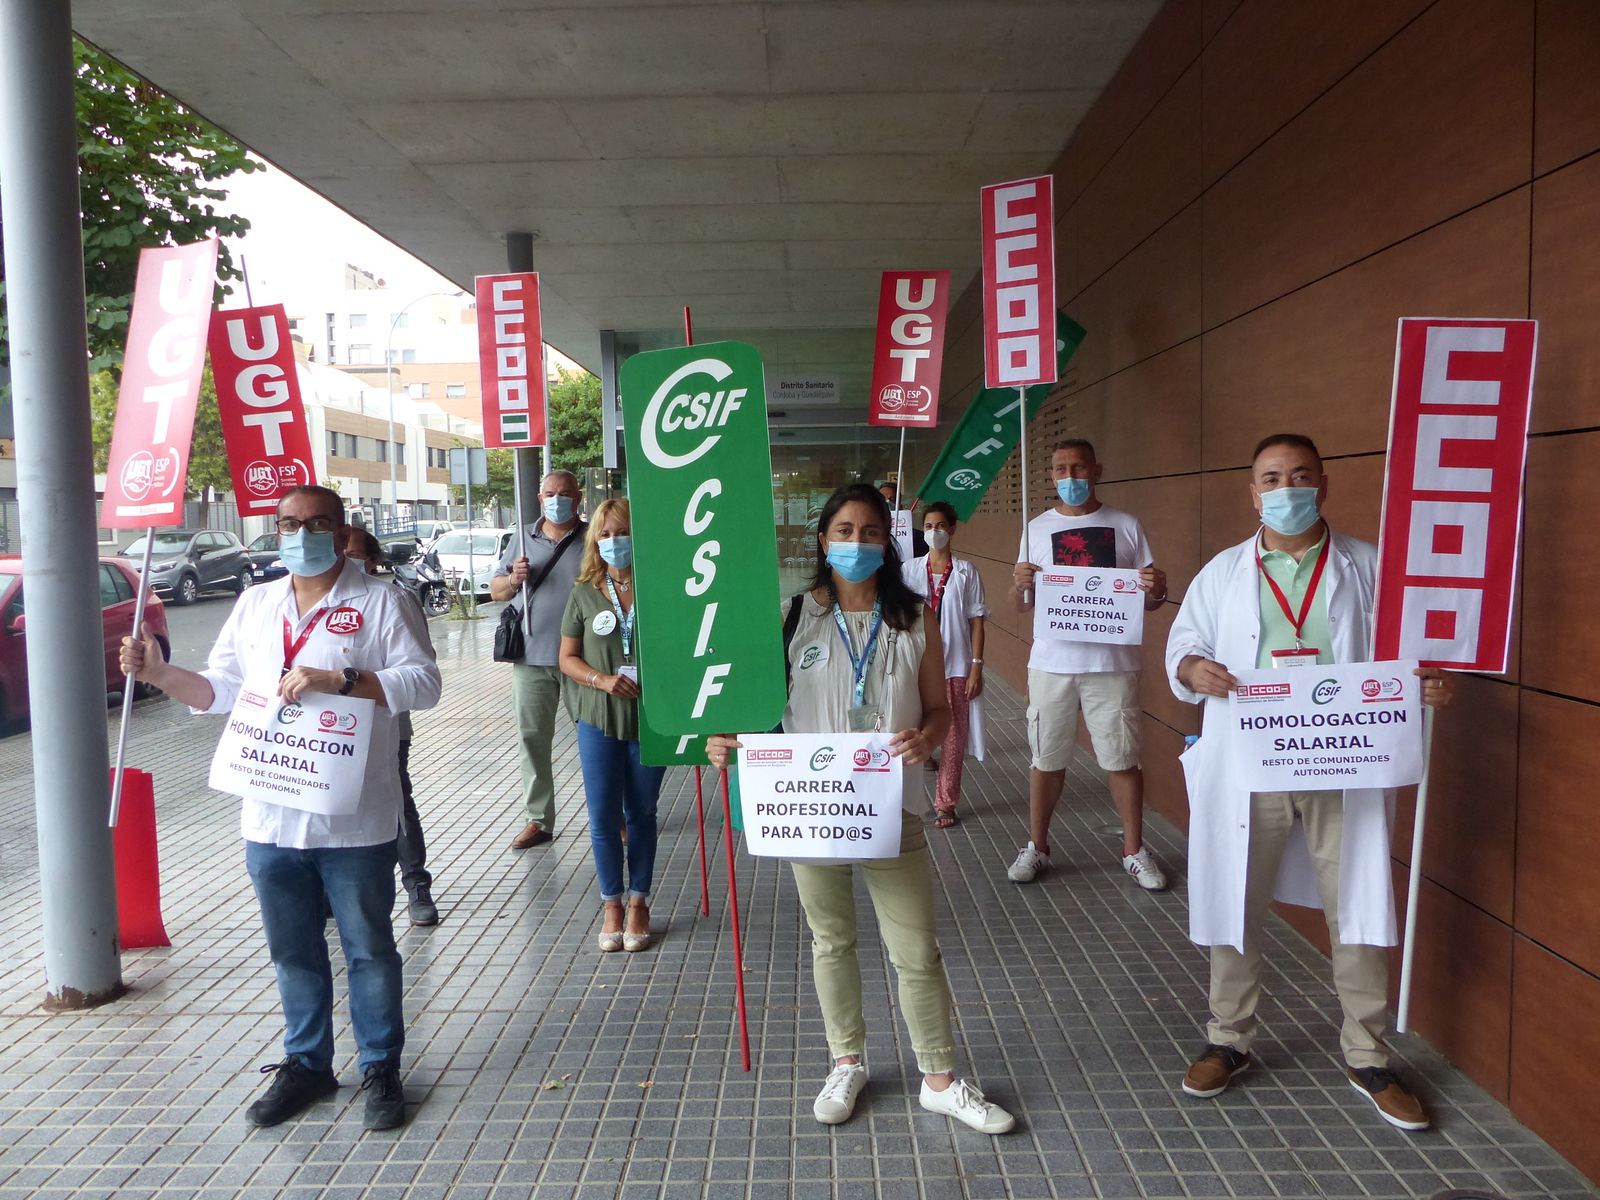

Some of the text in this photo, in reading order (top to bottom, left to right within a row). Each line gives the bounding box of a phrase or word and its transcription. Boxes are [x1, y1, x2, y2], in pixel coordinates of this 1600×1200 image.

[993, 182, 1040, 383] CCOO
[889, 278, 937, 382] UGT
[142, 252, 211, 445] UGT
[492, 279, 529, 411] CCOO
[226, 315, 294, 457] UGT
[780, 381, 834, 390] Distrito Sanitario
[882, 388, 902, 400] UGT
[248, 466, 272, 482] UGT
[1398, 326, 1506, 663] CCOO
[683, 478, 732, 719] CSIF
[1061, 595, 1115, 606] CARRERA
[332, 611, 358, 625] UGT
[1047, 607, 1128, 620] PROFESIONAL
[1050, 621, 1124, 634] PARA TOD@S
[1240, 709, 1407, 730] HOMOLOGACION
[230, 719, 355, 757] HOMOLOGACION
[1274, 735, 1374, 751] SALARIAL
[240, 746, 319, 774] SALARIAL
[1262, 754, 1390, 766] RESTO DE COMUNIDADES
[229, 762, 330, 790] RESTO DE COMUNIDADES
[1293, 767, 1358, 777] AUTONOMAS
[249, 778, 301, 796] AUTONOMAS
[774, 780, 856, 793] CARRERA
[756, 803, 878, 817] PROFESIONAL
[761, 826, 873, 841] PARA TOD@S
